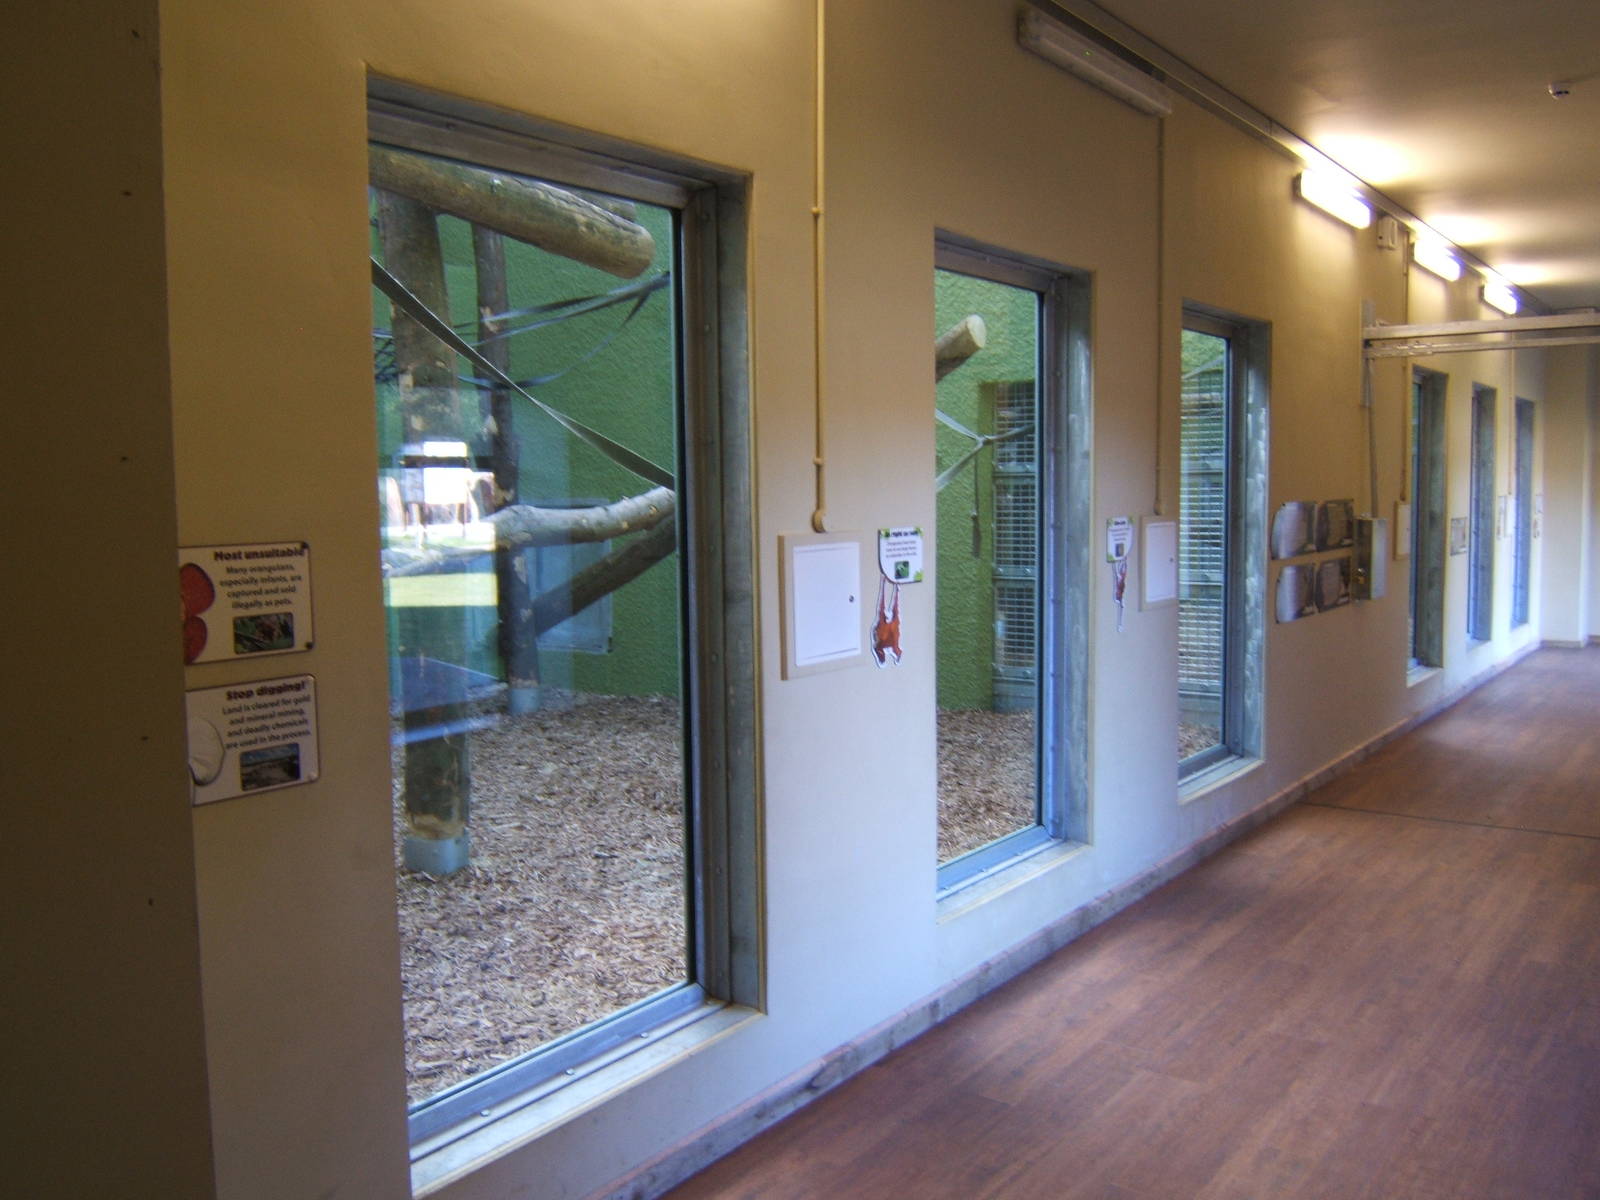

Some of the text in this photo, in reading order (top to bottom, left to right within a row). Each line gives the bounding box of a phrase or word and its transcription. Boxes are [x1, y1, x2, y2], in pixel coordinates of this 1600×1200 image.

[214, 551, 242, 560] Most
[226, 566, 247, 574] Many
[220, 576, 258, 586] especially
[226, 584, 296, 598] captured and sold
[232, 600, 262, 609] illegally
[226, 681, 304, 700] Stop digging!
[222, 704, 242, 714] Land
[252, 699, 280, 710] cleared
[292, 694, 310, 704] gold
[229, 715, 244, 725] and
[246, 711, 276, 720] mineral
[228, 718, 308, 737] and deadly chemicals
[239, 738, 258, 746] used
[268, 734, 280, 742] the
